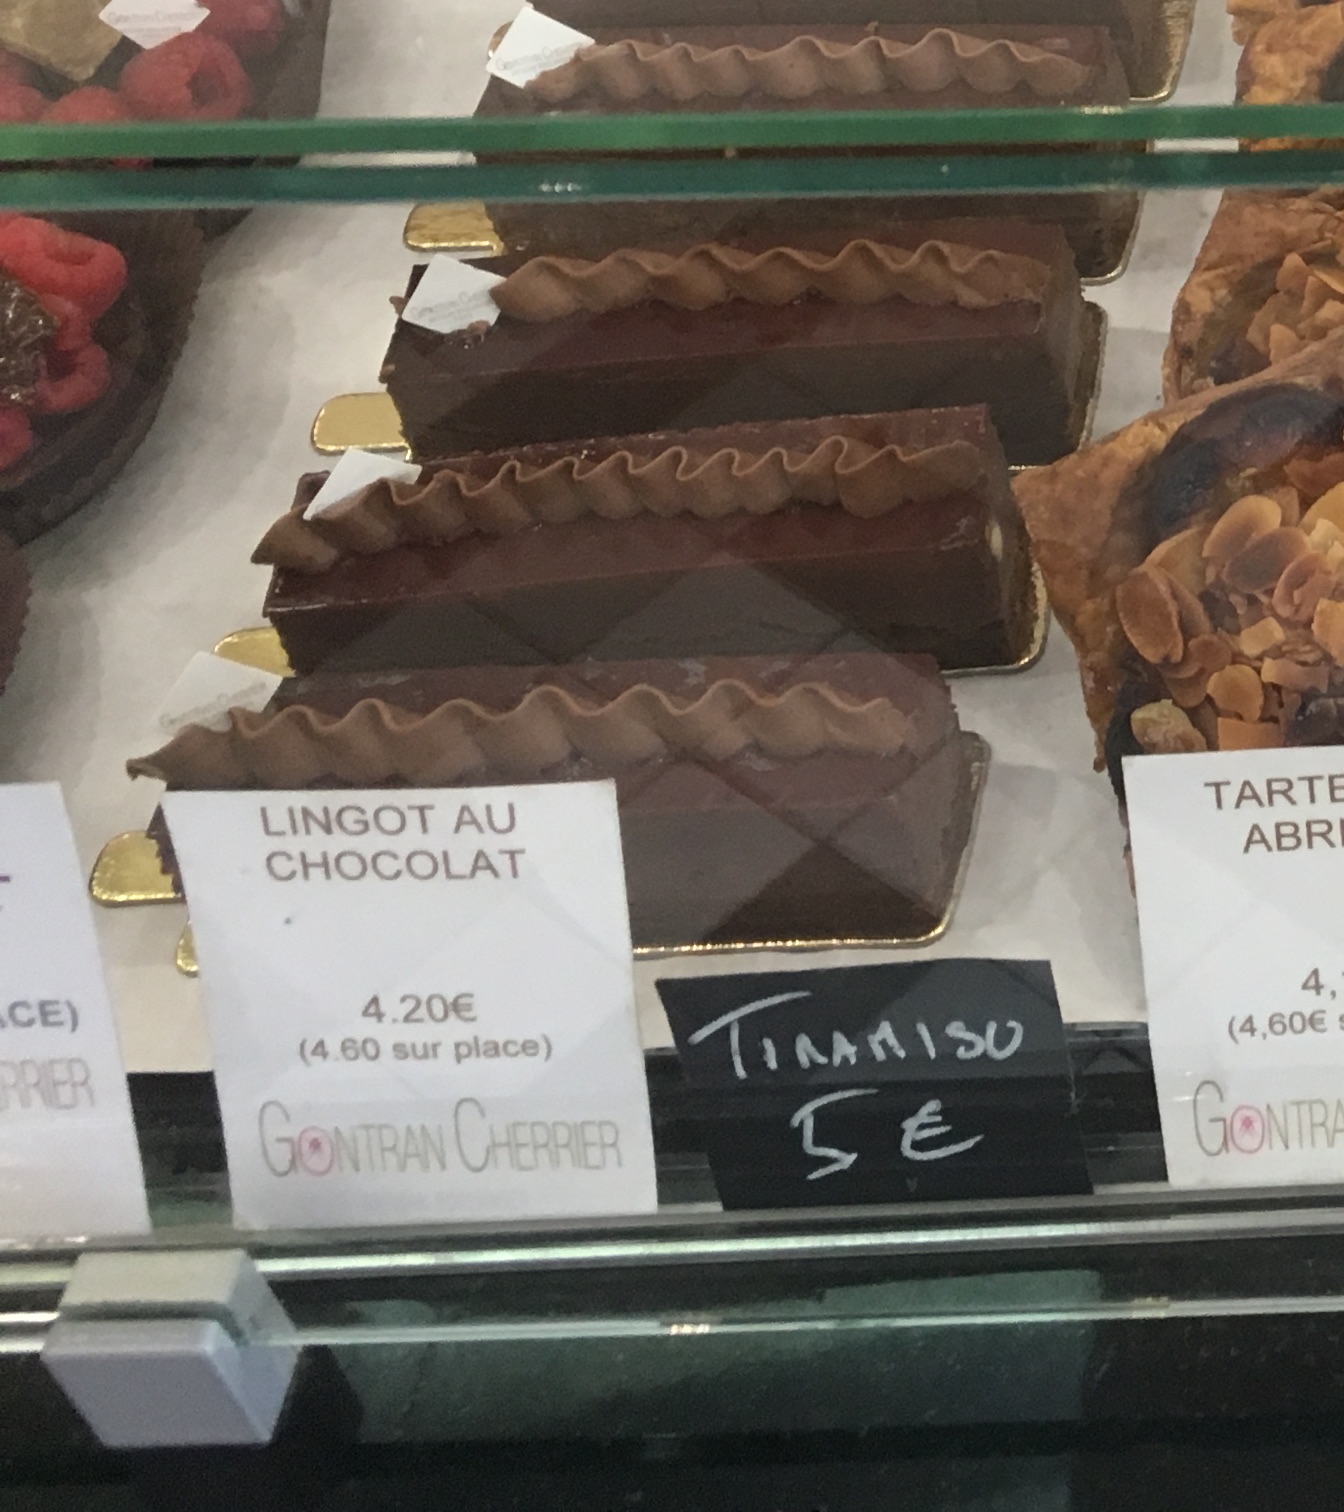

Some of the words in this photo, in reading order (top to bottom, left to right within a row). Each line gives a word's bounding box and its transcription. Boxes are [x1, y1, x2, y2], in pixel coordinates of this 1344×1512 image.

[260, 805, 434, 836] LINGOT
[453, 803, 516, 835] AU
[266, 849, 524, 881] CHOCOLAT
[0, 1000, 78, 1032] CE)
[362, 993, 476, 1023] 4.20€
[1228, 1010, 1326, 1044] (4,60€
[299, 1038, 380, 1066] (4.60
[392, 1042, 441, 1060] sur
[454, 1035, 552, 1064] place)
[791, 1089, 876, 1179] 5
[901, 1100, 982, 1160] €
